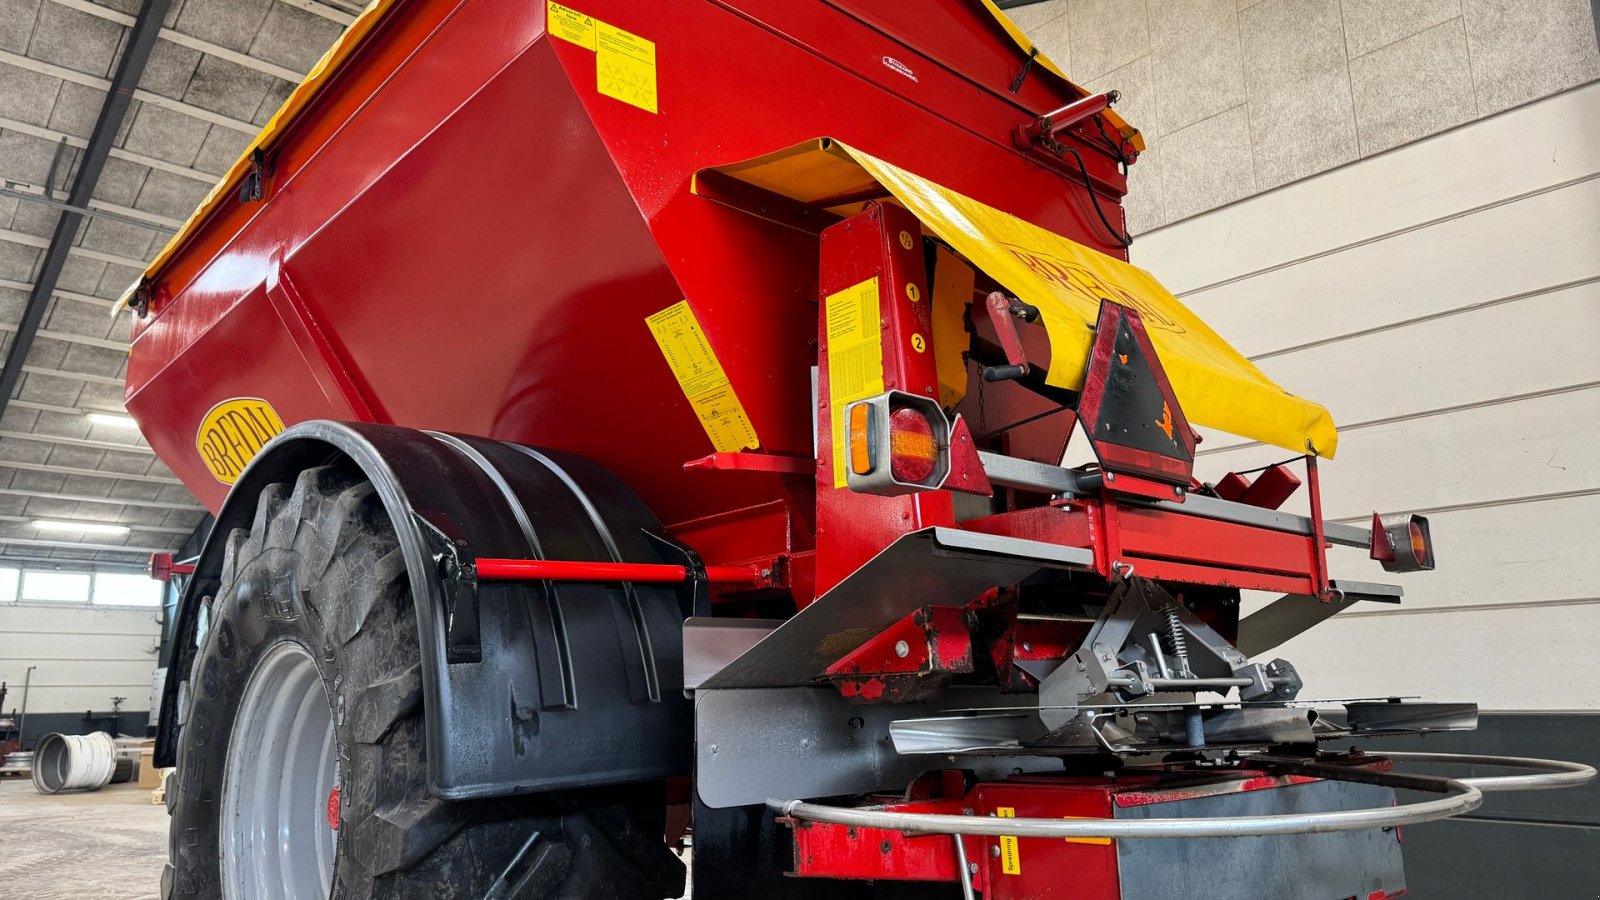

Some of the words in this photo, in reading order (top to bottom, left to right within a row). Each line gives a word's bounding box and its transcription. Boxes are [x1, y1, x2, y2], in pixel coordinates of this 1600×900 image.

[909, 286, 915, 299] 1
[915, 336, 923, 350] 2
[1006, 838, 1014, 871] Spredning
